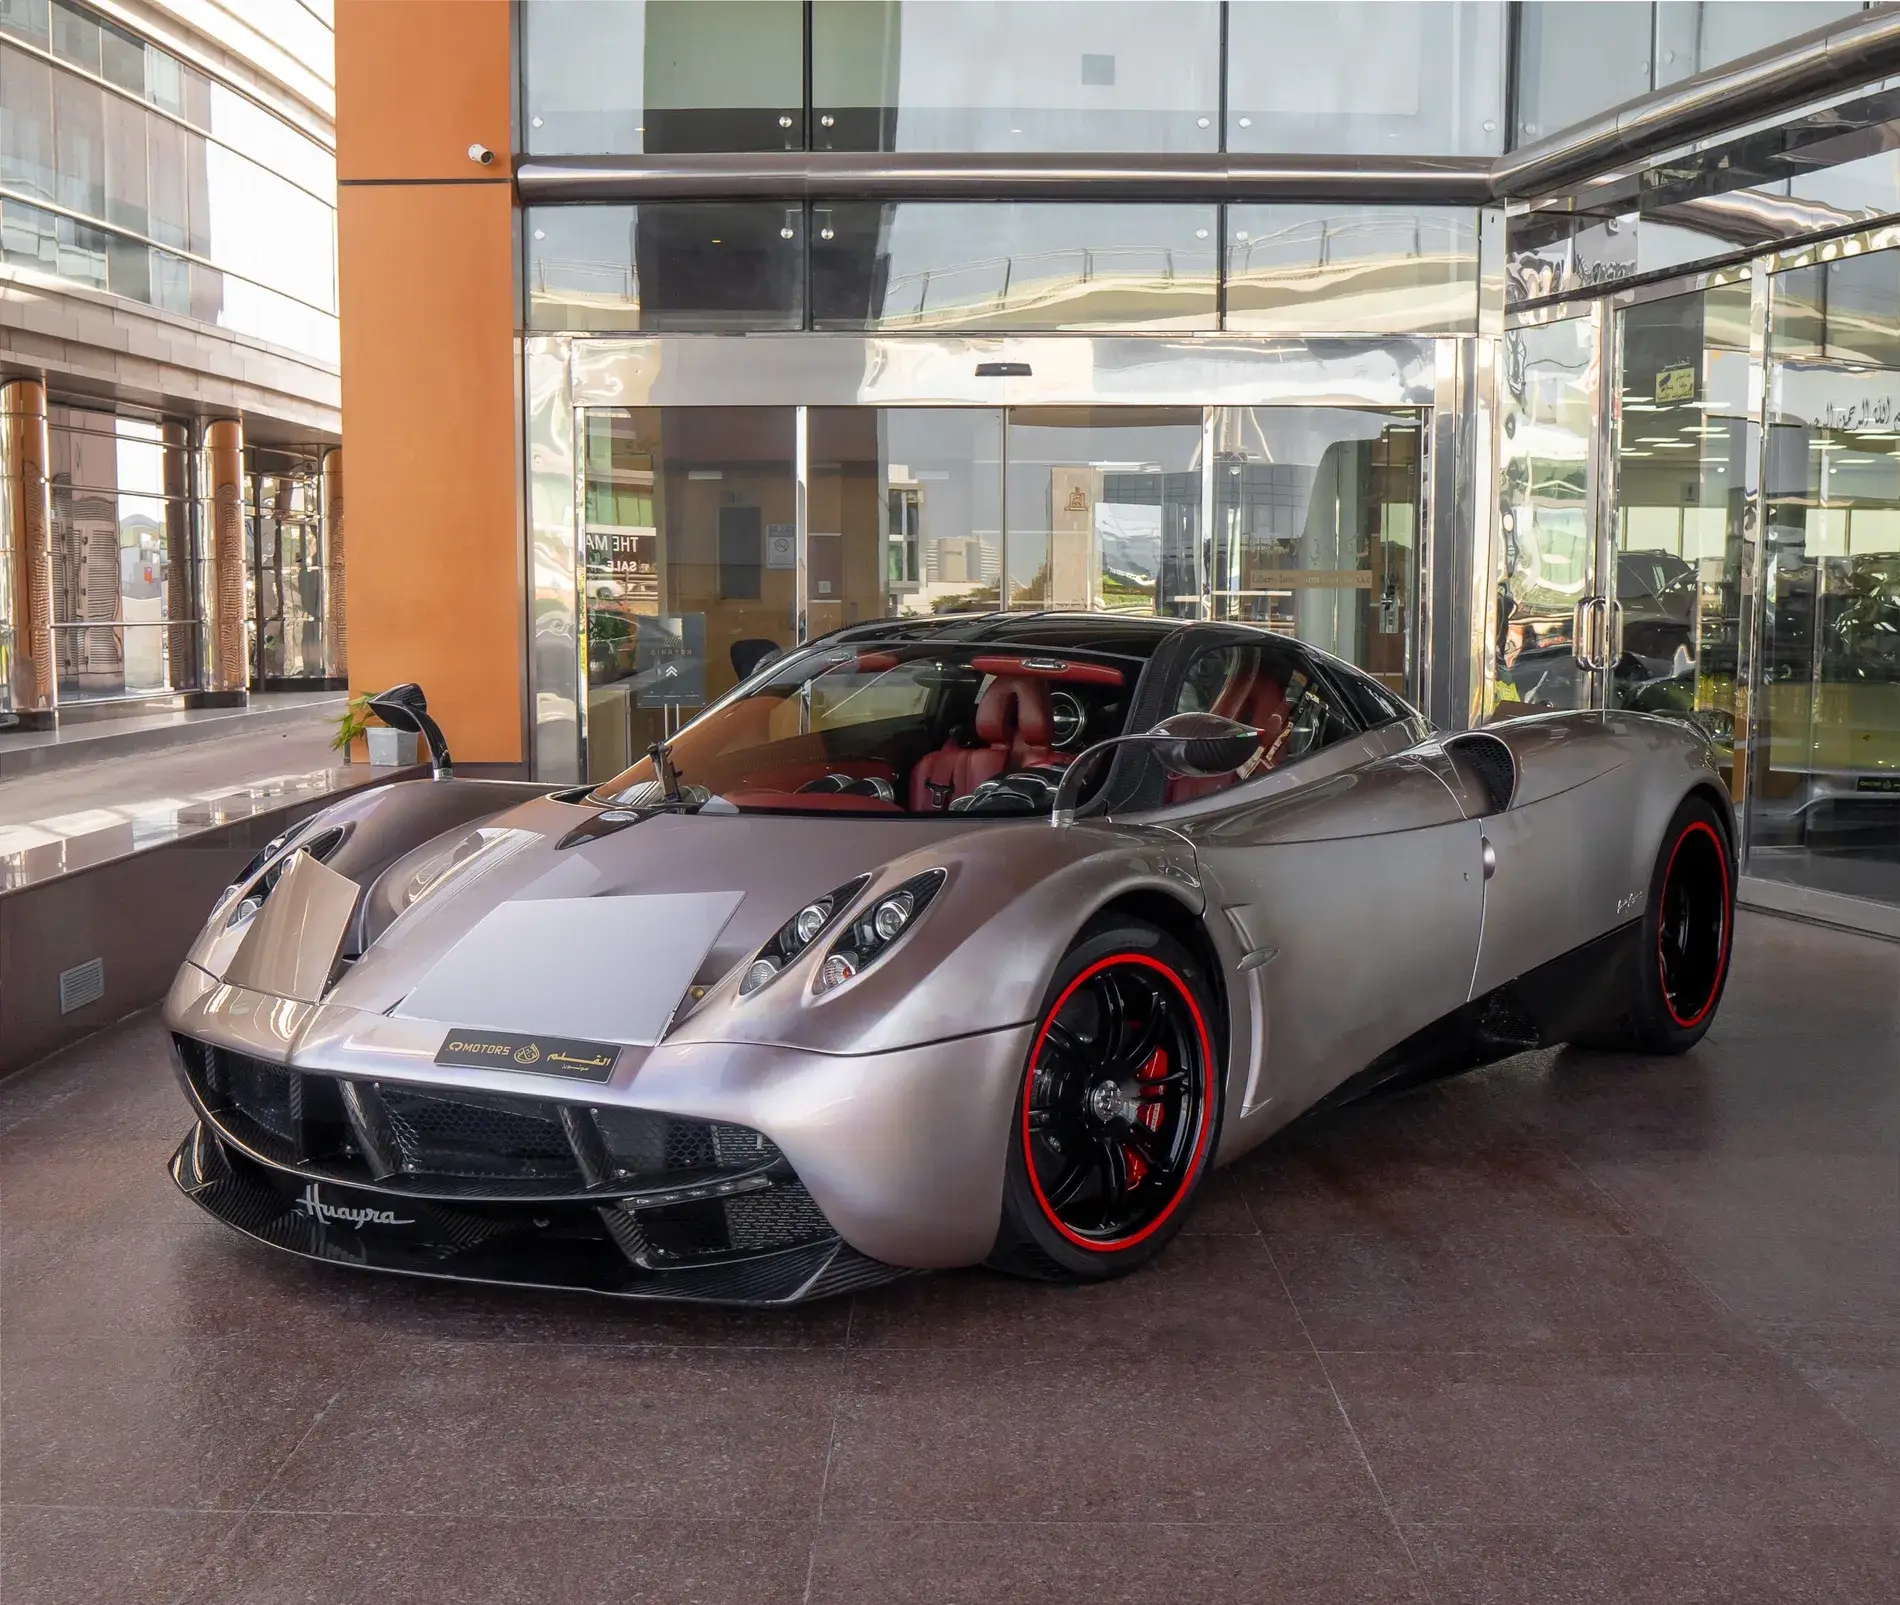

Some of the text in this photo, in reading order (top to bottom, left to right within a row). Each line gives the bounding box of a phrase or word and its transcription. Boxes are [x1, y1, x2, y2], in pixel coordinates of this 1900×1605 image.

[1836, 398, 1870, 433] الرحمن
[1873, 396, 1891, 425] الله
[545, 1051, 612, 1067] القلم
[295, 1183, 416, 1230] Huayra
